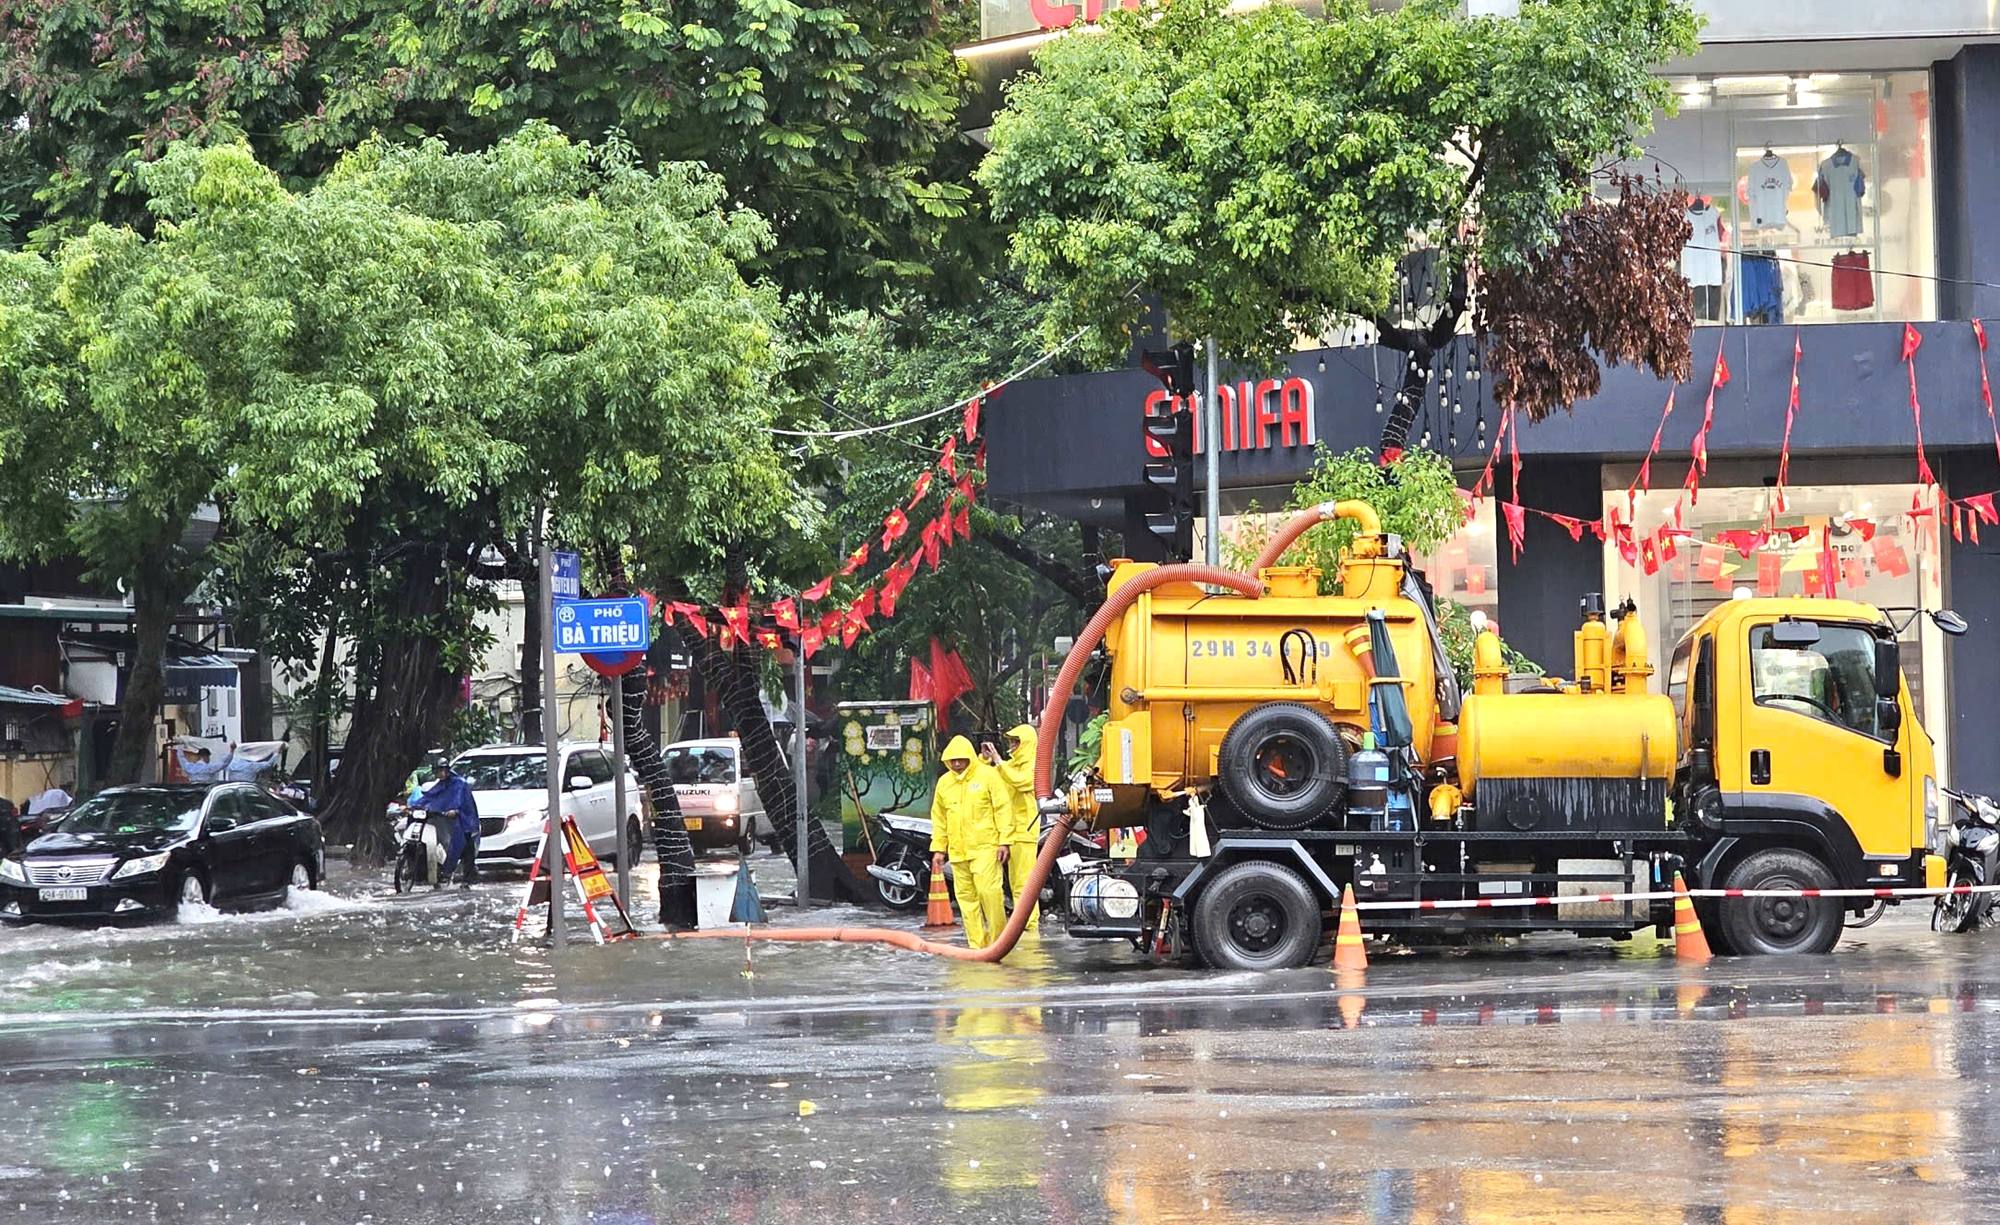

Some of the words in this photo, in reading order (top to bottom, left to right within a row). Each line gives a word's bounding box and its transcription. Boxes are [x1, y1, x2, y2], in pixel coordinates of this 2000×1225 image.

[593, 605, 623, 618] PHỐ
[562, 622, 586, 645] BÀ
[590, 620, 639, 646] TRIỆU
[1192, 640, 1234, 657] 29H
